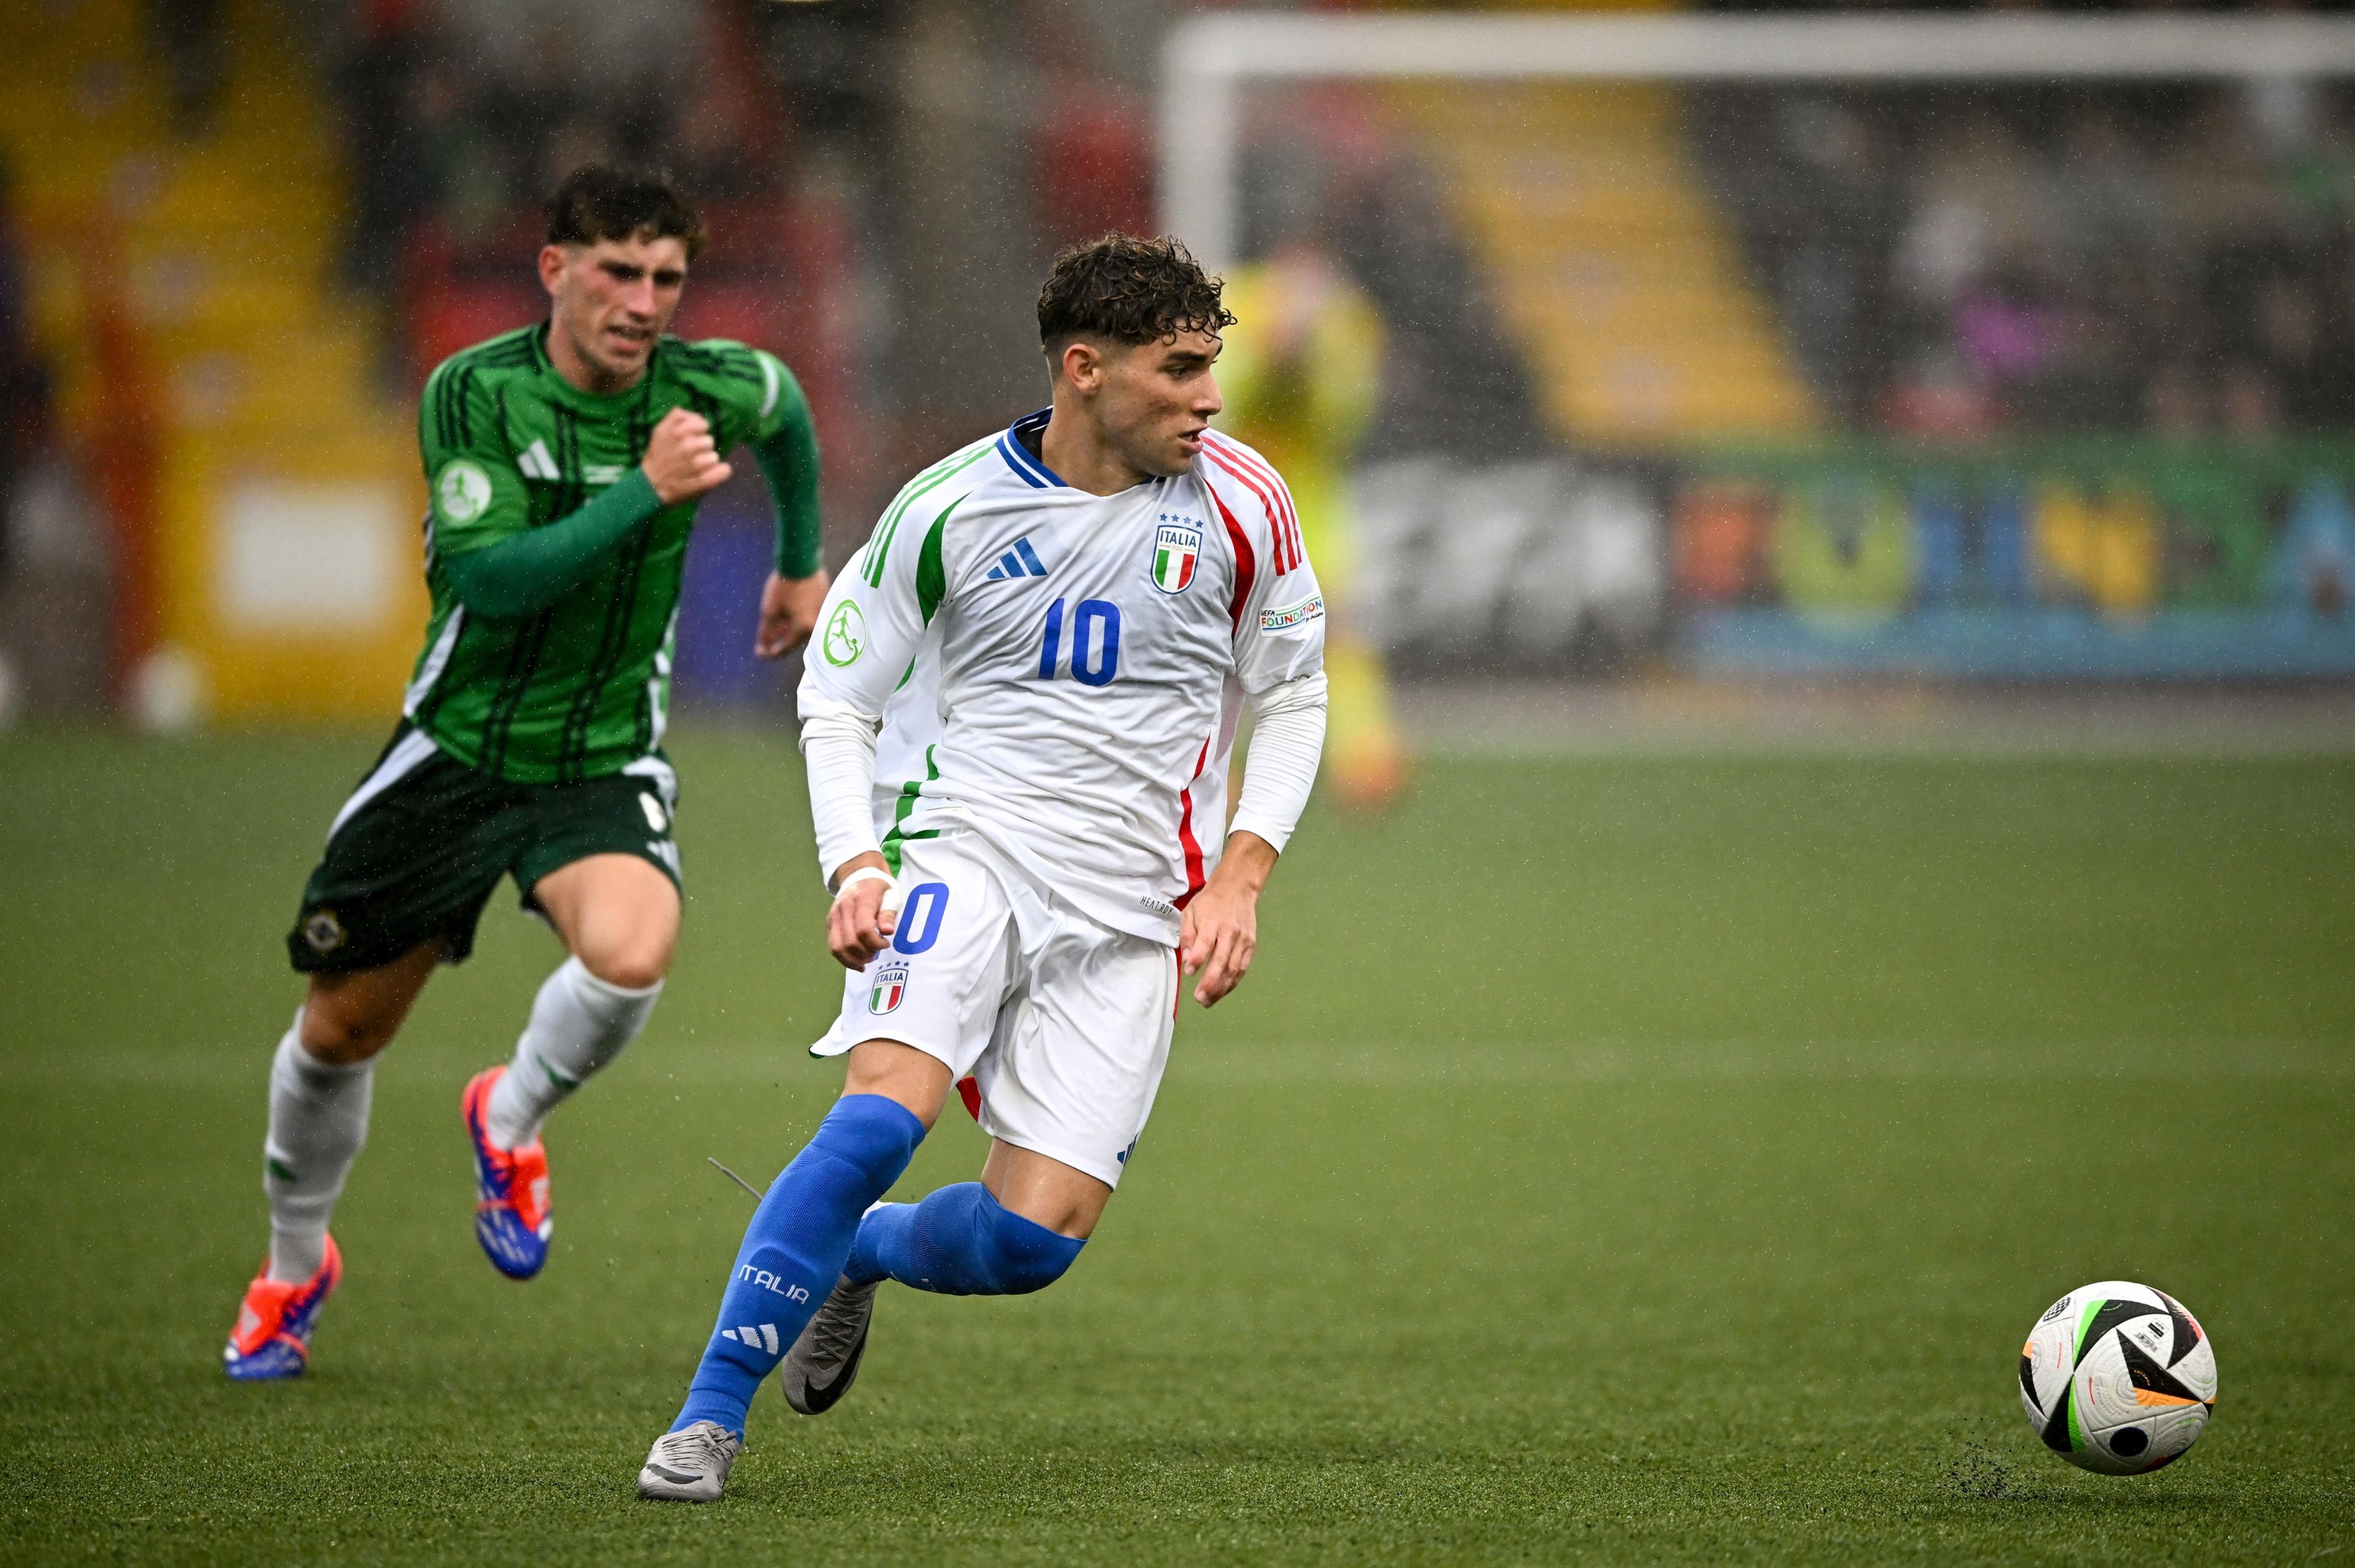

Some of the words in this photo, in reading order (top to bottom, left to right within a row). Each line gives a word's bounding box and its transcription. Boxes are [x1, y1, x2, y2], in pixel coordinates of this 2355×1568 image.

[1160, 530, 1197, 548] ITALIA
[1261, 599, 1322, 627] FOUNDATION
[1038, 597, 1121, 687] 10
[1139, 895, 1174, 916] HEAT.RDY
[873, 882, 949, 960] 0
[876, 972, 903, 984] ITALIA
[738, 1264, 810, 1305] ITALIA
